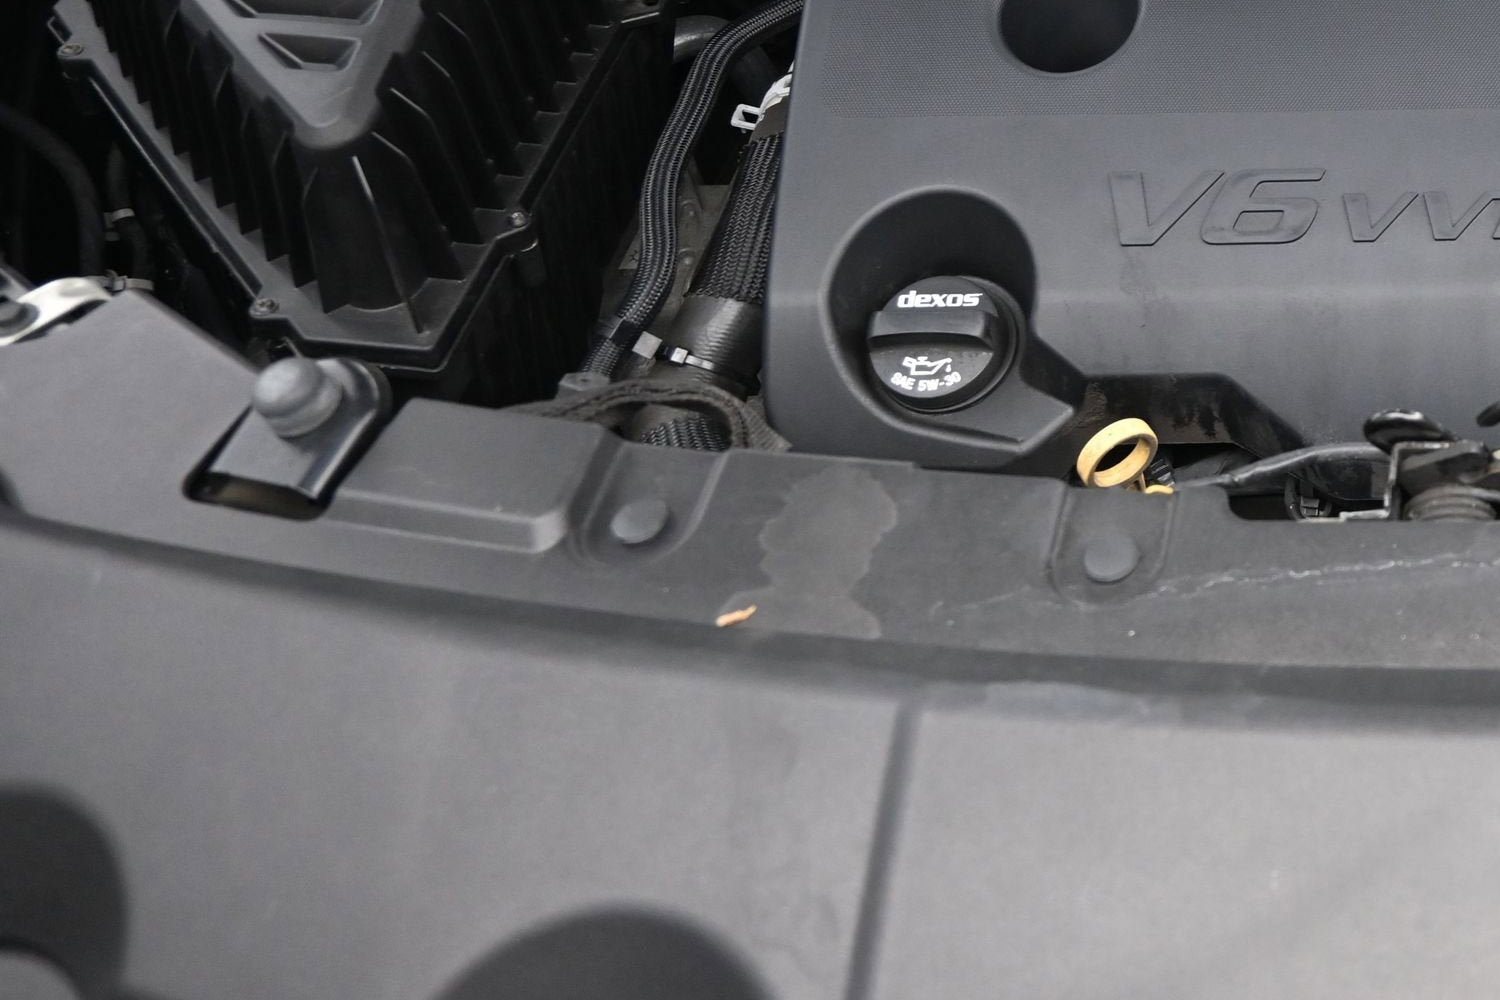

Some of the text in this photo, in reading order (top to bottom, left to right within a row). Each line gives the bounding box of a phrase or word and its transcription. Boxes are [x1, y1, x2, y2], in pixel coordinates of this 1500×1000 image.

[1107, 168, 1326, 247] V6
[897, 290, 983, 308] dexos
[890, 371, 962, 391] SAE 5W-30
